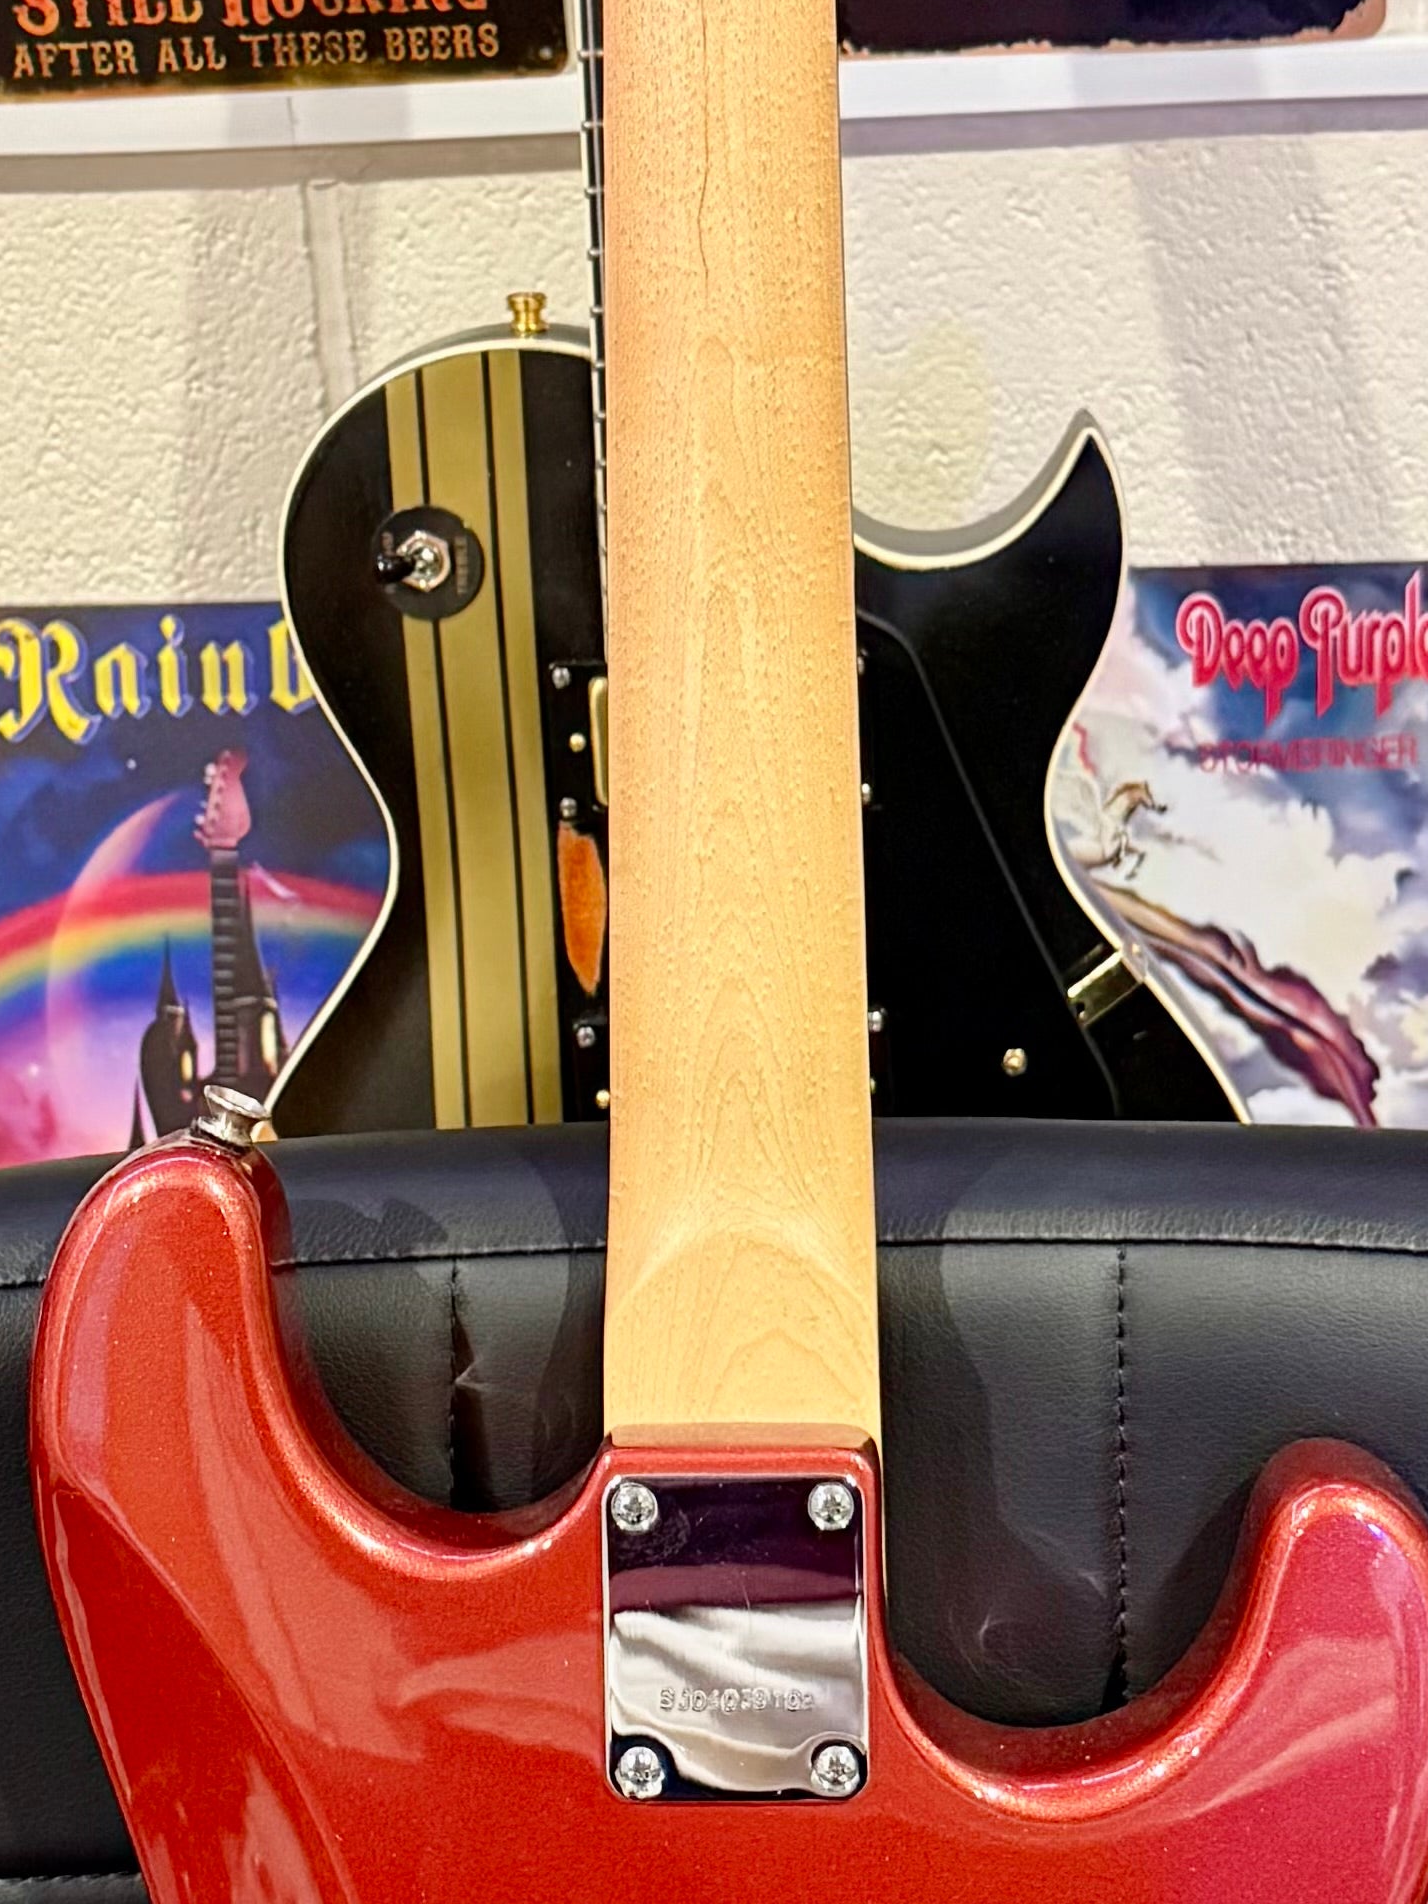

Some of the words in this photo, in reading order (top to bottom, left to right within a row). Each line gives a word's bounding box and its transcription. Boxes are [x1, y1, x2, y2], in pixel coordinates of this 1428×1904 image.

[14, 34, 139, 79] AFTER
[158, 32, 228, 73] ALL
[238, 27, 371, 68] THESE
[384, 20, 500, 61] BEERS
[1176, 592, 1300, 727] Deep
